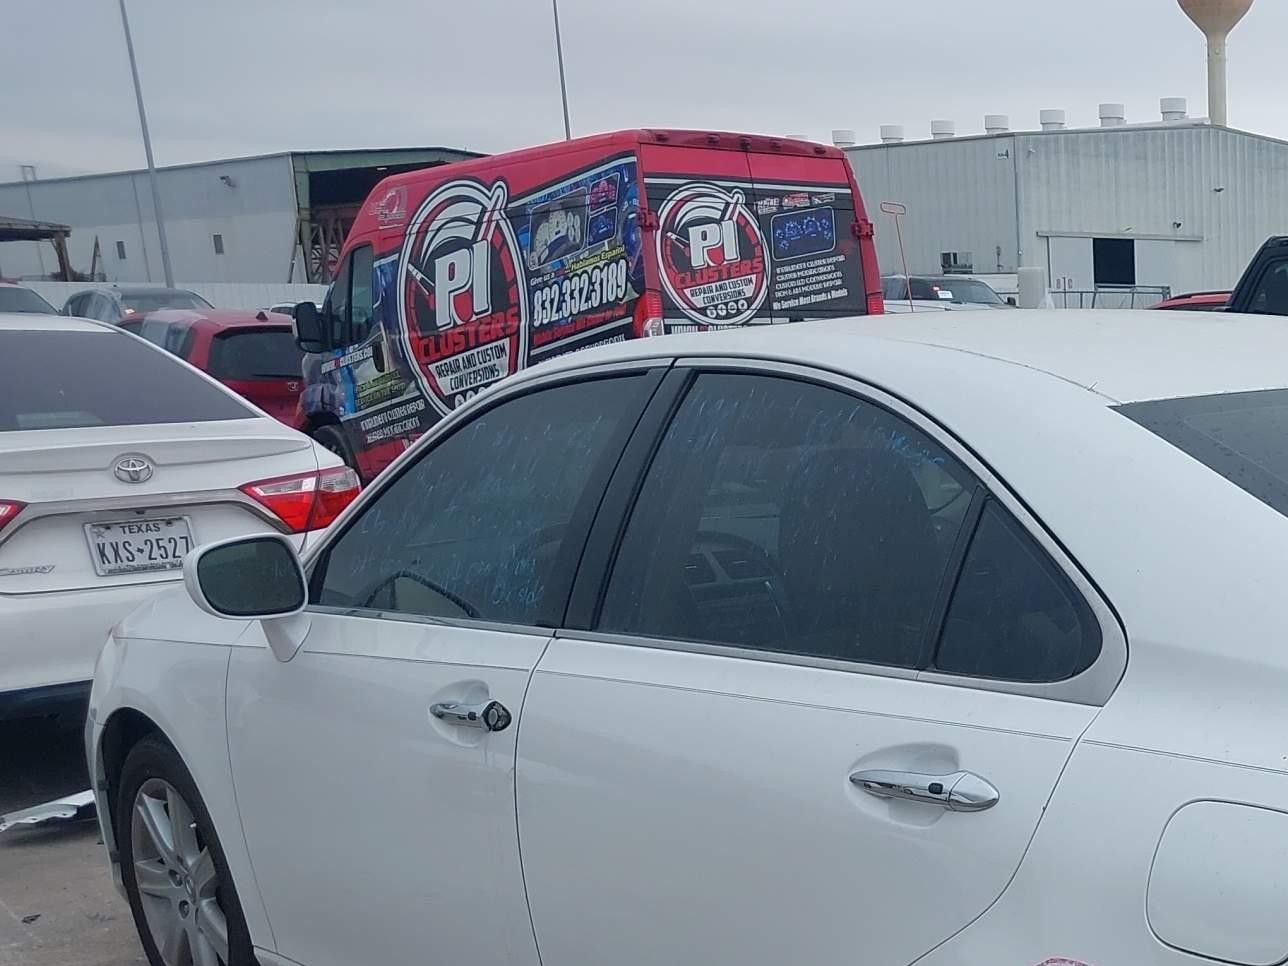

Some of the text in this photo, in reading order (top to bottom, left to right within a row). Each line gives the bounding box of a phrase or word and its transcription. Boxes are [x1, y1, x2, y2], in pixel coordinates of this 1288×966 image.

[689, 220, 738, 267] PI
[435, 240, 489, 327] PI
[676, 260, 763, 287] CLUSTERS
[690, 276, 754, 297] REPAIR AND CUSTOM
[533, 259, 627, 327] 832.332.3189
[702, 290, 746, 305] CONVERSIONS
[418, 311, 519, 361] CLUSTERS
[434, 343, 507, 379] REPAIR AND CUSTOM
[450, 364, 501, 391] CONVERSIONS
[120, 523, 160, 534] TEXAS
